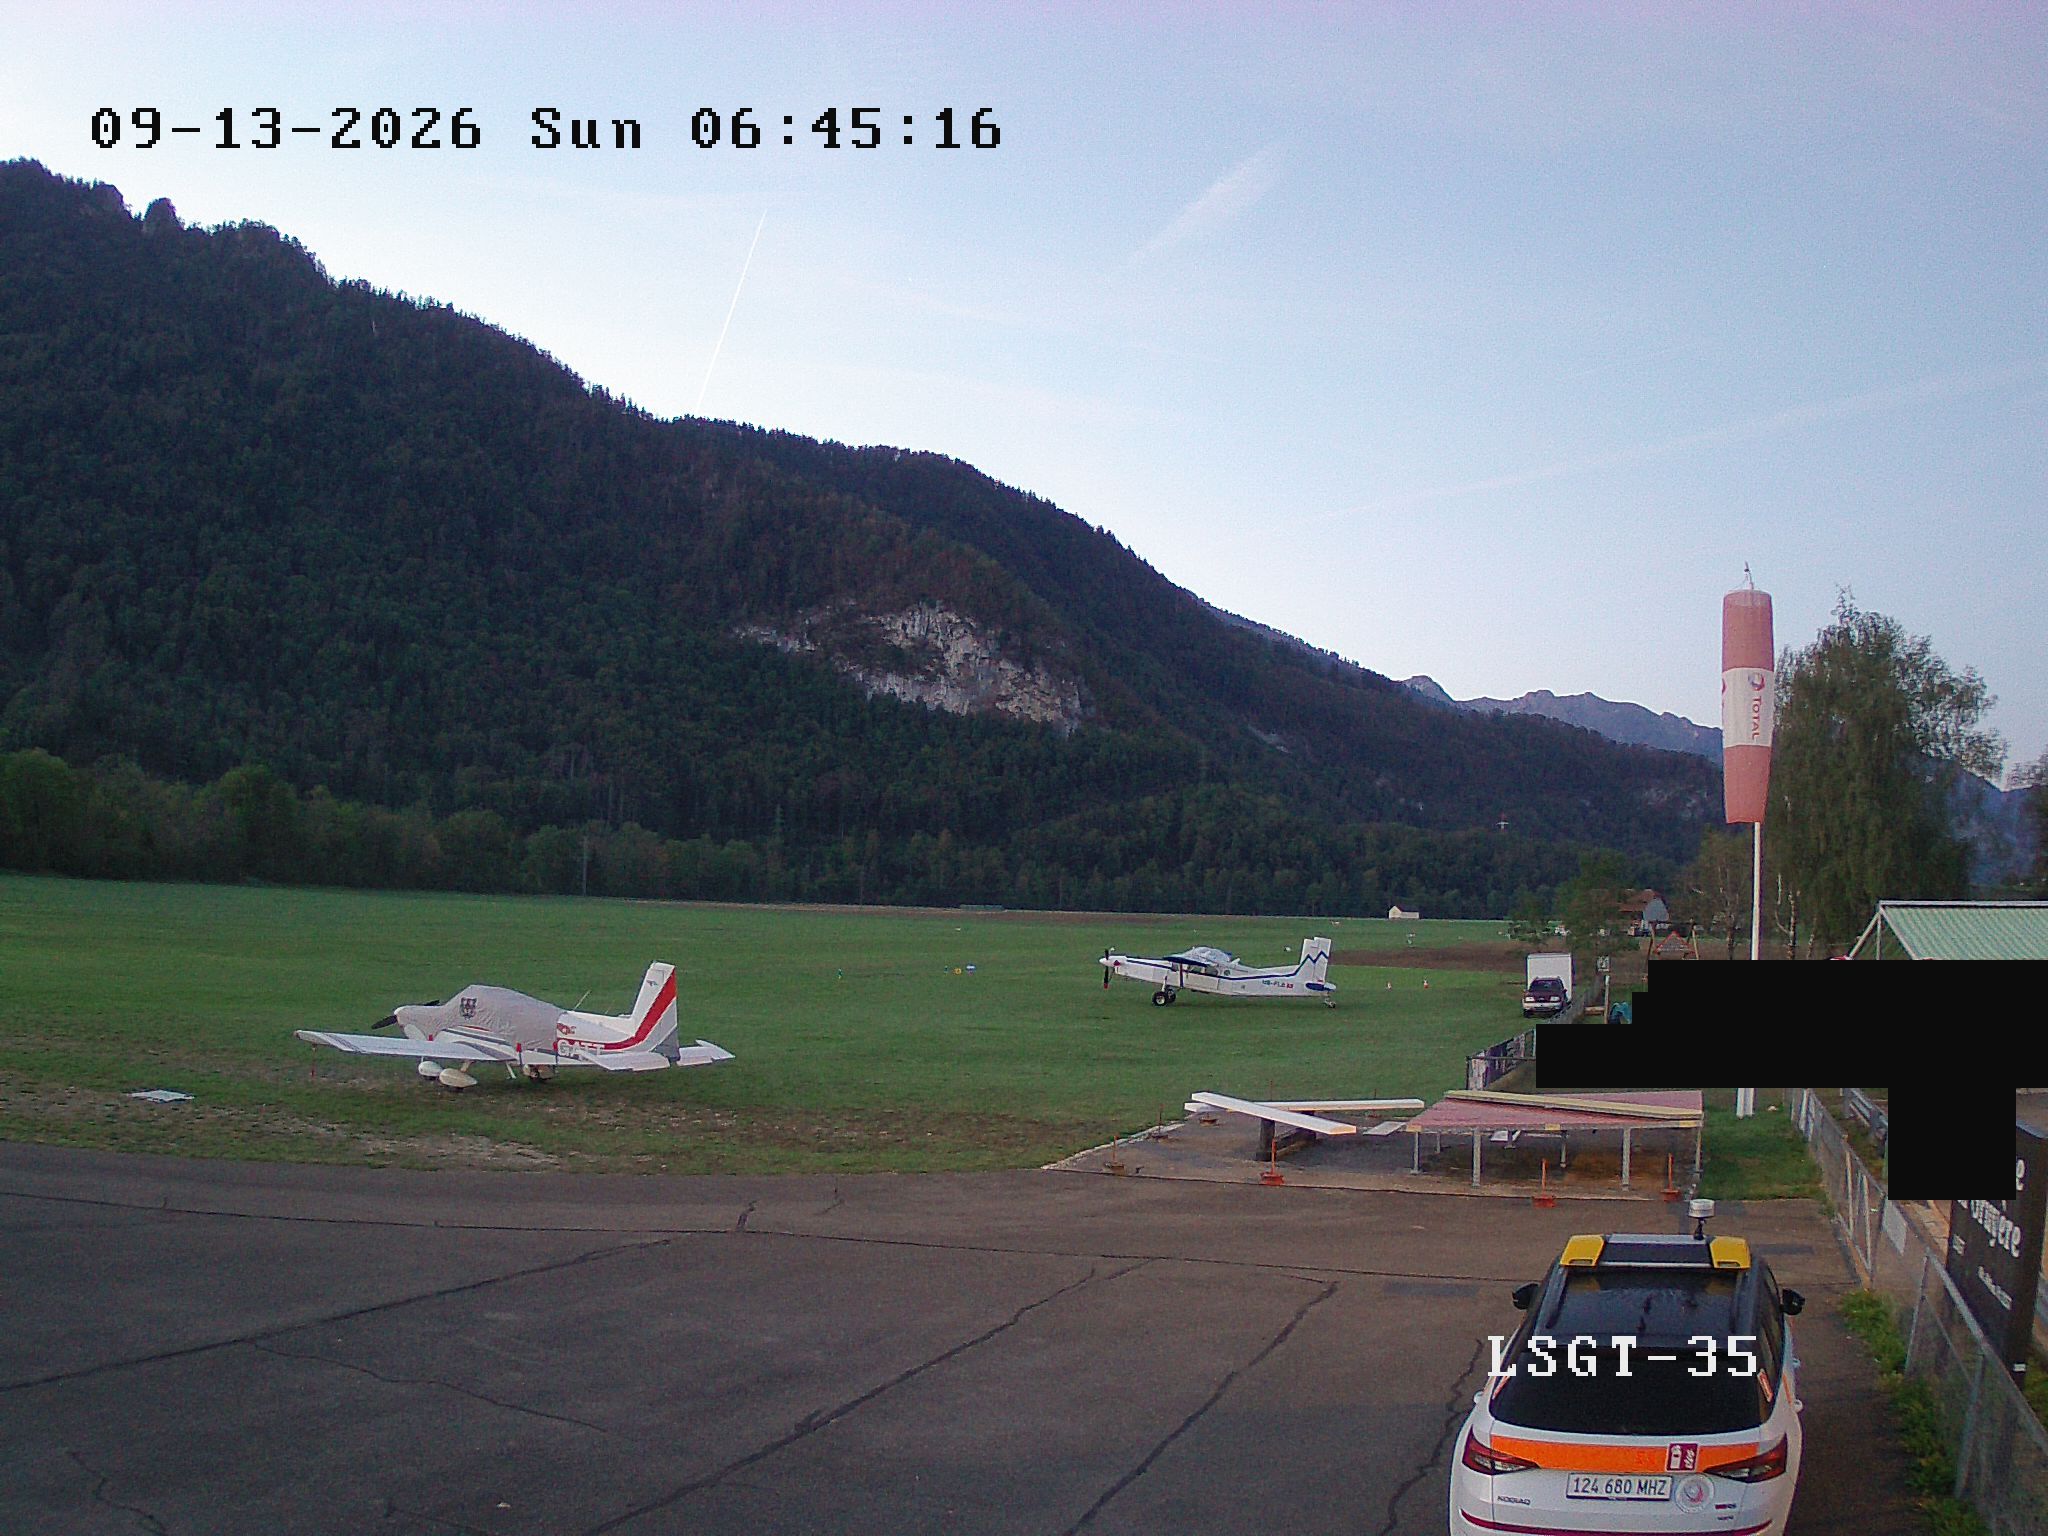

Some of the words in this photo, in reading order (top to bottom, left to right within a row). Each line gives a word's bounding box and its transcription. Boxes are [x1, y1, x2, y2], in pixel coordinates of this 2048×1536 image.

[1751, 695, 1762, 740] TOTAL
[1573, 1477, 1599, 1493] 124
[1604, 1478, 1632, 1494] 680
[1636, 1479, 1667, 1495] MHZ
